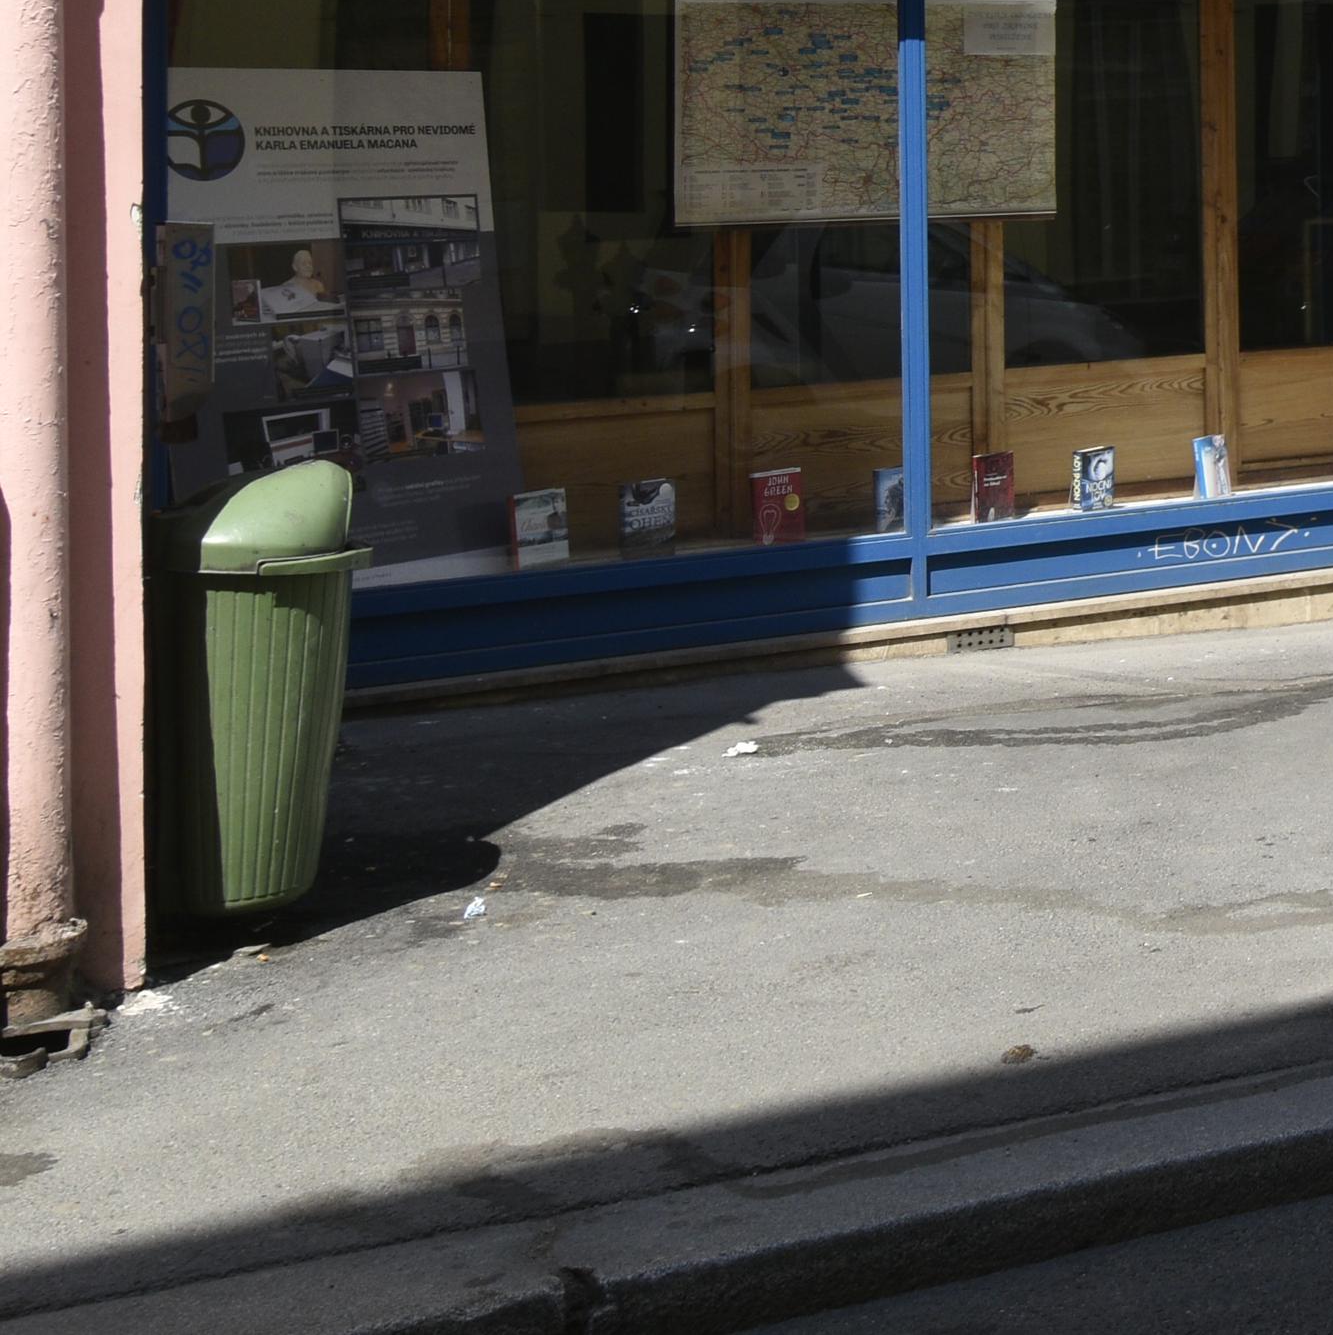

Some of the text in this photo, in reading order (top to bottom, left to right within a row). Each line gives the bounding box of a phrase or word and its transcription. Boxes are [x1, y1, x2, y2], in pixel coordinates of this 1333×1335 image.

[254, 122, 476, 137] KNIHOVNA A TISKÁRNA PRO NEVIDOMÉ
[255, 138, 418, 151] KARLA EMANUELA MACANA
[767, 475, 790, 487] JOHN
[763, 484, 794, 498] GREEN
